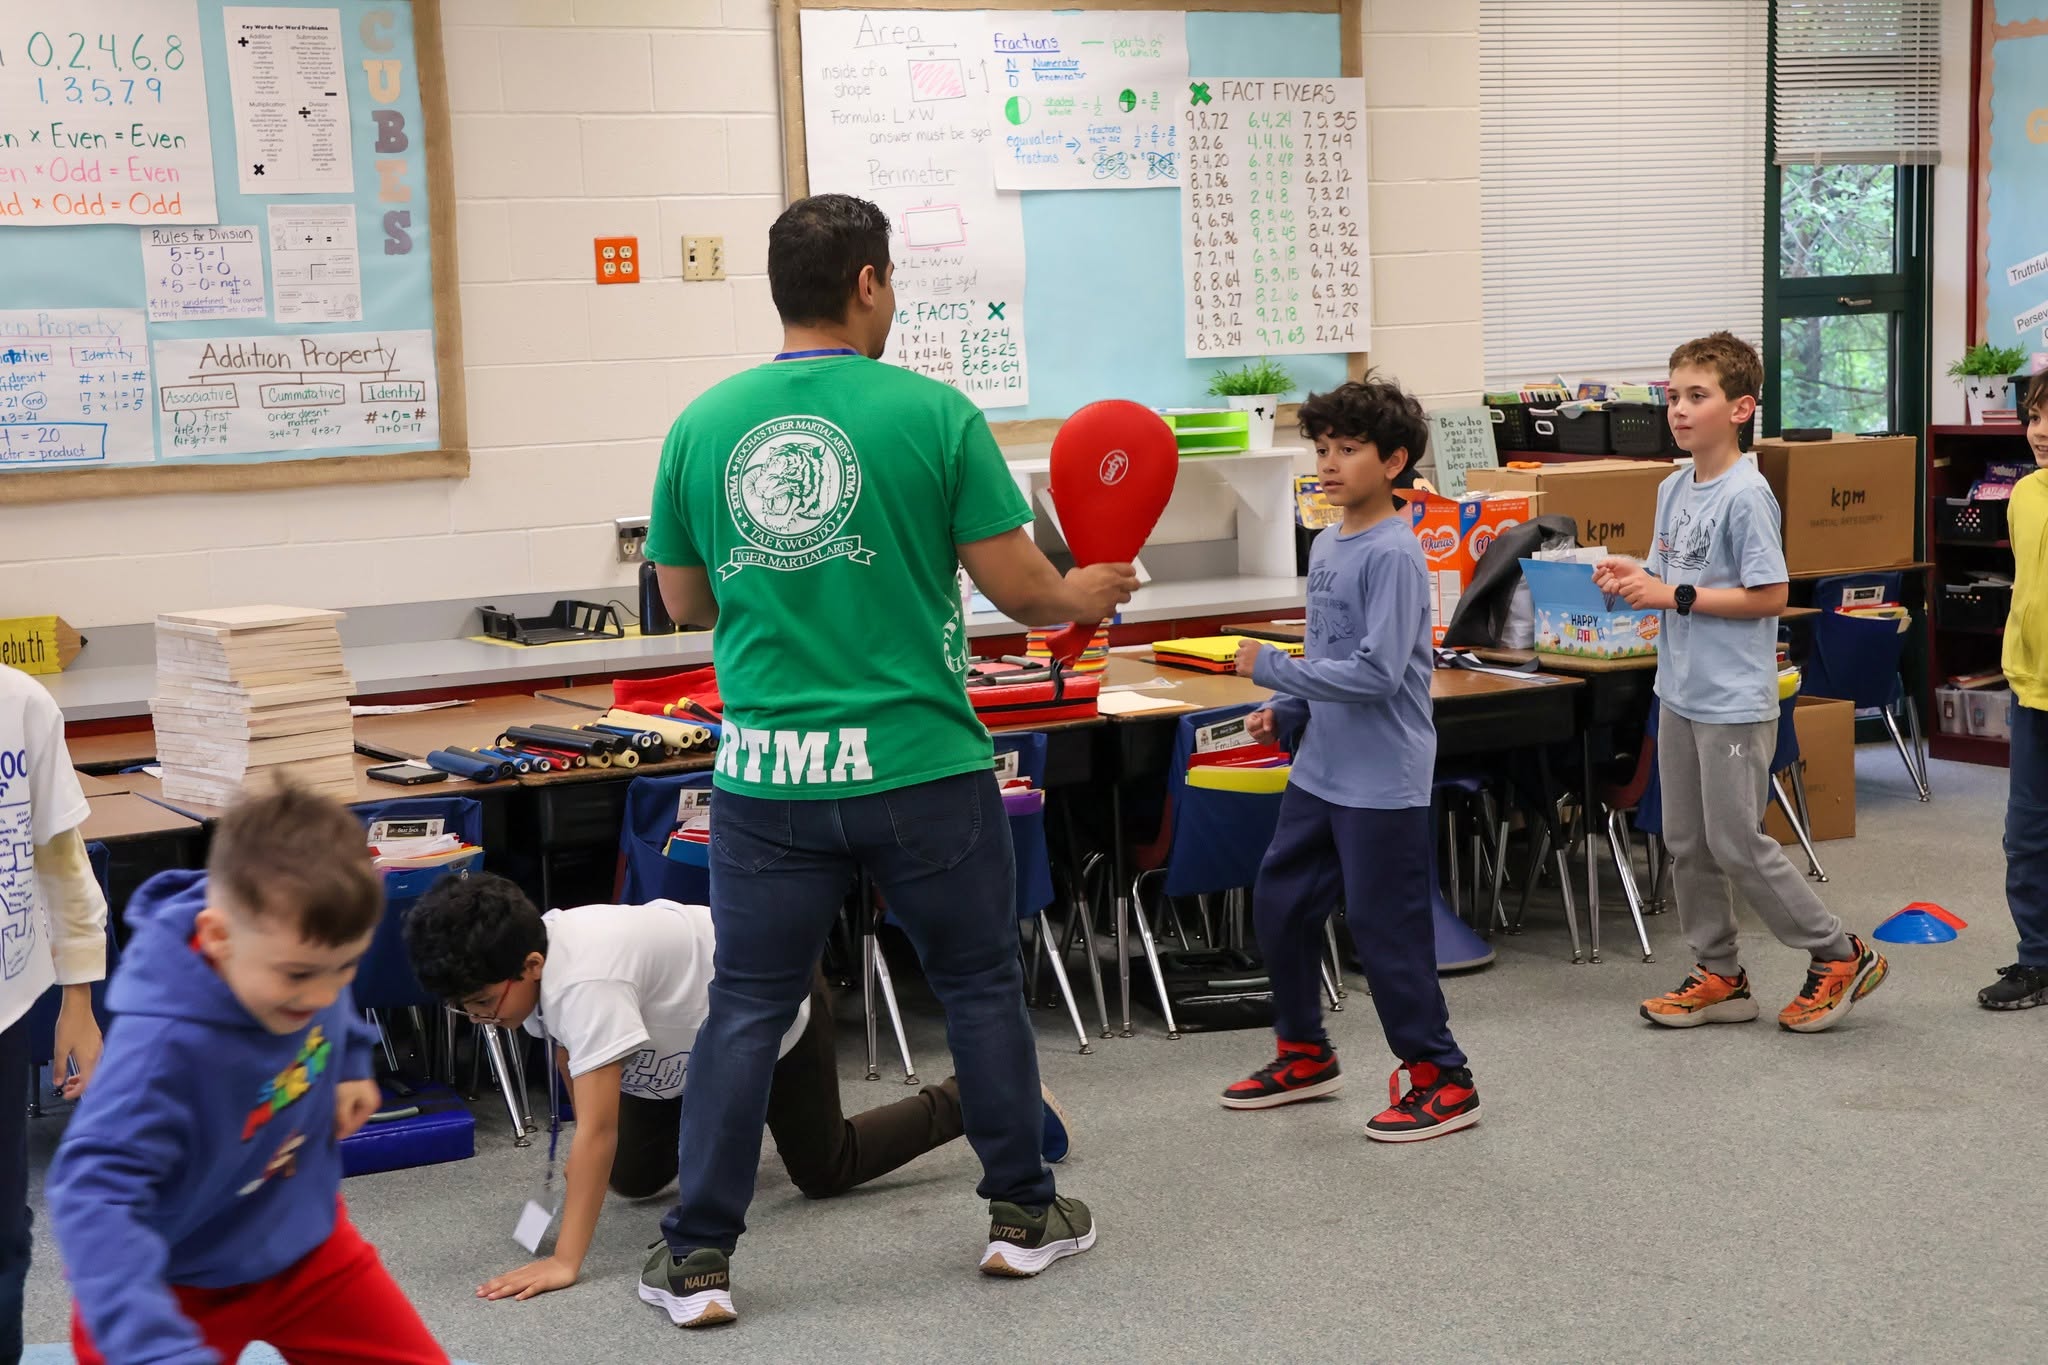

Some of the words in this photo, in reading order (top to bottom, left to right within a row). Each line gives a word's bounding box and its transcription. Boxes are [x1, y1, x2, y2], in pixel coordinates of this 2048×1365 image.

[856, 14, 924, 46] Area
[994, 33, 1058, 50] Fractions
[822, 61, 858, 80] inside
[1033, 58, 1080, 68] Numerator
[834, 83, 872, 99] shape
[1222, 81, 1264, 102] FACT
[1273, 82, 1336, 104] FIXERS
[51, 122, 106, 149] Even
[131, 123, 186, 148] Even
[870, 130, 912, 145] answer
[916, 127, 944, 142] must
[50, 156, 102, 183] Odd
[128, 156, 180, 182] Even
[867, 157, 956, 186] Perimeter
[53, 191, 105, 216] Odd
[129, 191, 182, 216] Odd
[152, 230, 188, 244] Rules
[193, 229, 204, 241] for
[208, 228, 253, 240] Division
[80, 347, 132, 364] Identity
[200, 342, 290, 369] Addition
[301, 338, 397, 376] Property
[166, 388, 234, 404] Associative
[368, 385, 421, 402] Identity
[204, 410, 232, 422] first
[1440, 418, 1454, 428] Be
[1458, 416, 1482, 426] who
[736, 431, 766, 465] ROCHA'S
[766, 421, 795, 438] TIGER
[795, 420, 834, 440] MARTIAL
[831, 436, 849, 457] ARTS
[1444, 431, 1462, 442] you
[1452, 435, 1466, 445] and
[1470, 436, 1482, 447] say
[1447, 460, 1488, 470] because
[844, 464, 856, 499] RTMA
[728, 475, 738, 510] RTMA
[1831, 487, 1866, 510] kpm
[1587, 520, 1625, 546] kpm
[768, 549, 826, 568] MARTIAL
[826, 540, 853, 554] ARTS
[1572, 614, 1598, 627] HAPPY
[715, 719, 873, 784] RTMA
[684, 1272, 728, 1290] NAUTICA
